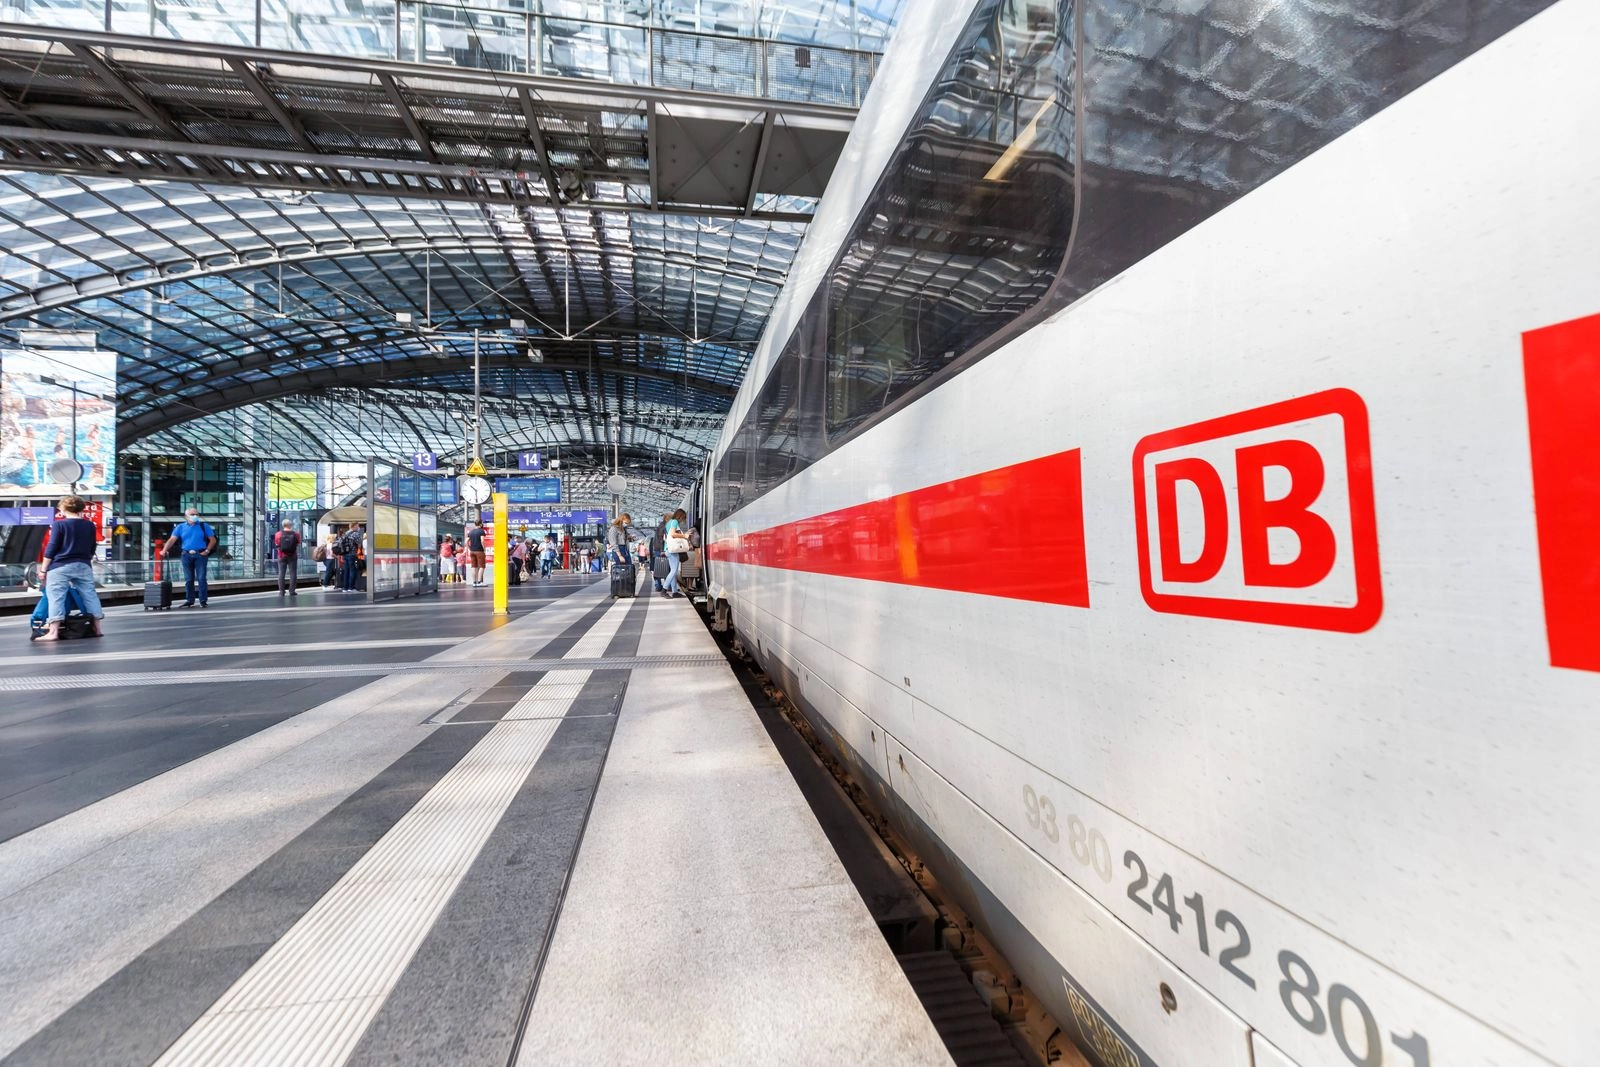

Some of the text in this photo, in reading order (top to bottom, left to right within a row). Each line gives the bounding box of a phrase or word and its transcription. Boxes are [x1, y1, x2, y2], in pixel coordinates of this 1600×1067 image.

[415, 453, 432, 467] 13
[523, 453, 538, 467] 14
[269, 500, 316, 511] DATEV
[1155, 439, 1337, 588] DB
[1022, 784, 1060, 843] 93
[1066, 813, 1112, 883] 80
[1123, 849, 1257, 991] 2412
